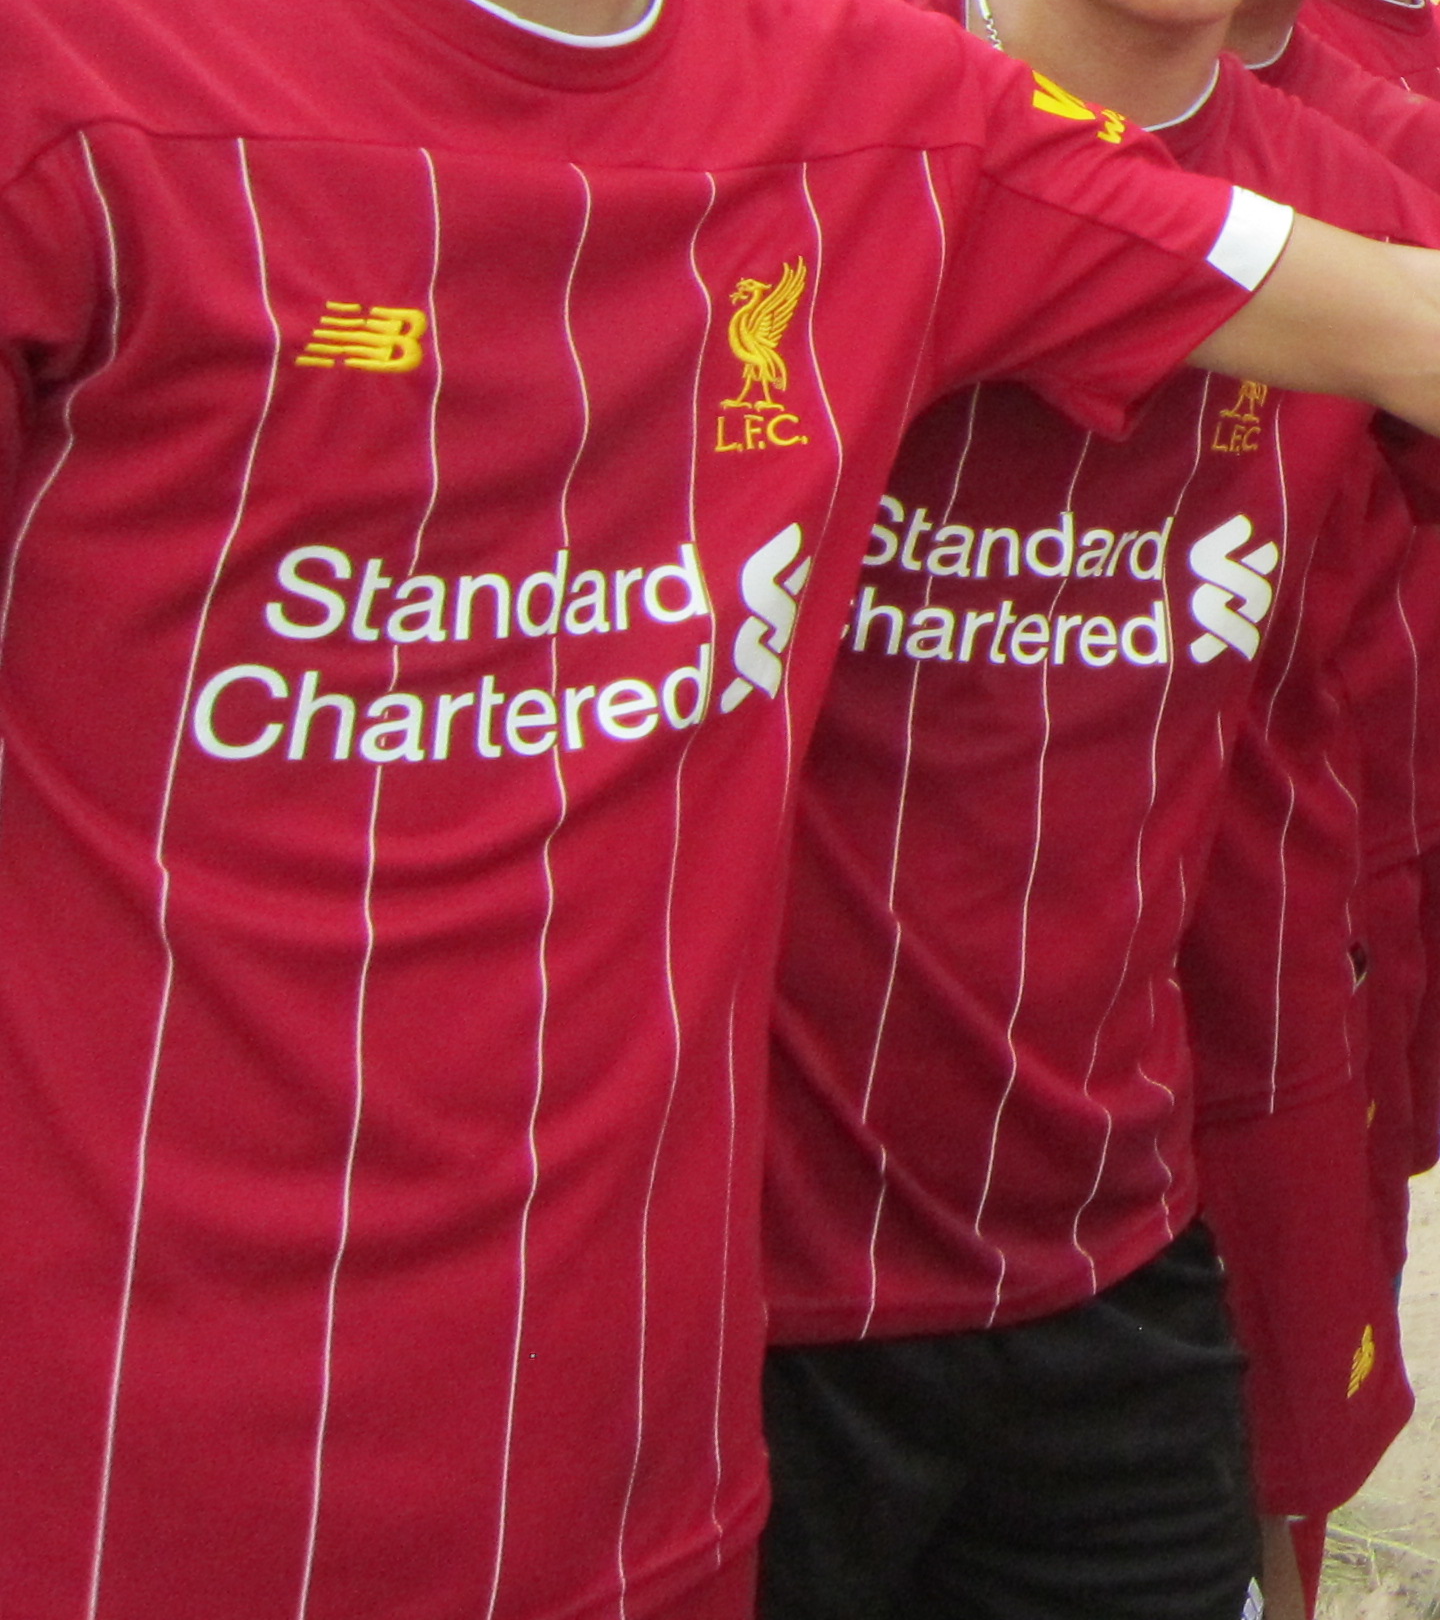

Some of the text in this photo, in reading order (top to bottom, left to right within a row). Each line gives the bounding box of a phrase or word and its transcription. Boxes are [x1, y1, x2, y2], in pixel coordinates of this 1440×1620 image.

[714, 413, 809, 452] L.F.C.
[863, 494, 1175, 580] Standard
[265, 543, 711, 643] Standard
[842, 587, 1174, 666] hartered
[193, 642, 712, 763] Chartered
